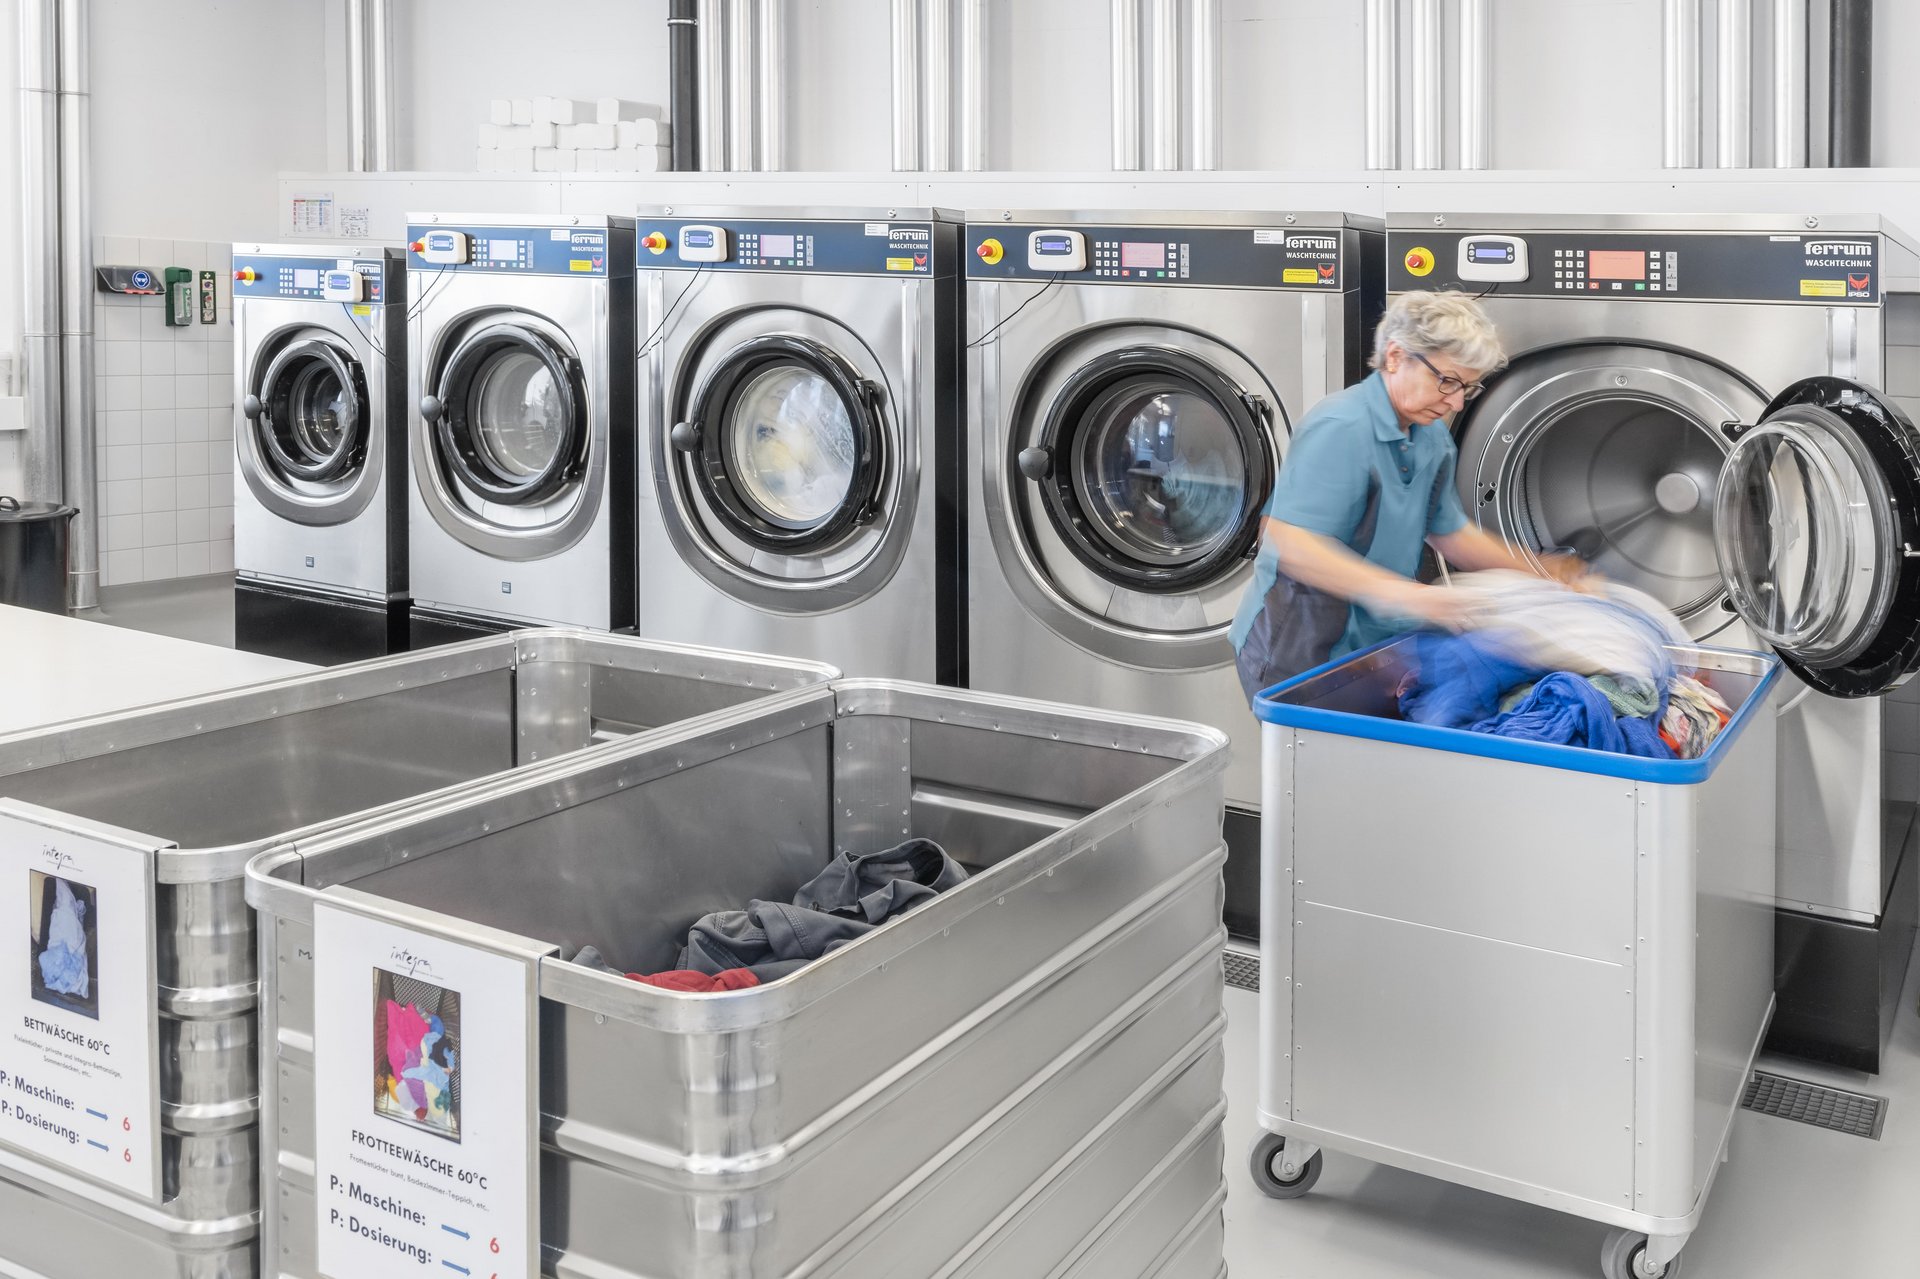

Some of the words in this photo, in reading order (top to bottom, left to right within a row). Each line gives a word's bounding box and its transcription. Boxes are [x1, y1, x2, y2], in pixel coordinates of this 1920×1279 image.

[571, 233, 604, 244] ferrum
[889, 228, 929, 241] ferrum
[1285, 235, 1337, 249] ferrum
[1804, 240, 1872, 256] ferrum
[1805, 259, 1872, 267] WASCHTECHNIK
[391, 946, 432, 976] integra
[24, 1016, 85, 1047] BETTWÄSCHE
[87, 1037, 111, 1056] 60°C
[0, 1070, 11, 1087] P:
[15, 1076, 75, 1111] Maschine:
[123, 1117, 131, 1131] 6
[1, 1100, 12, 1116] P:
[16, 1105, 80, 1144] Dosierung:
[124, 1148, 132, 1163] 6
[352, 1130, 454, 1178] FROTTEEWÄSCHE
[458, 1169, 488, 1190] 60°C
[390, 1168, 406, 1182] bunt,
[330, 1174, 343, 1194] P:
[349, 1182, 426, 1226] Maschine:
[489, 1237, 500, 1254] 6
[331, 1208, 344, 1228] P:
[350, 1216, 432, 1264] Dosierung:
